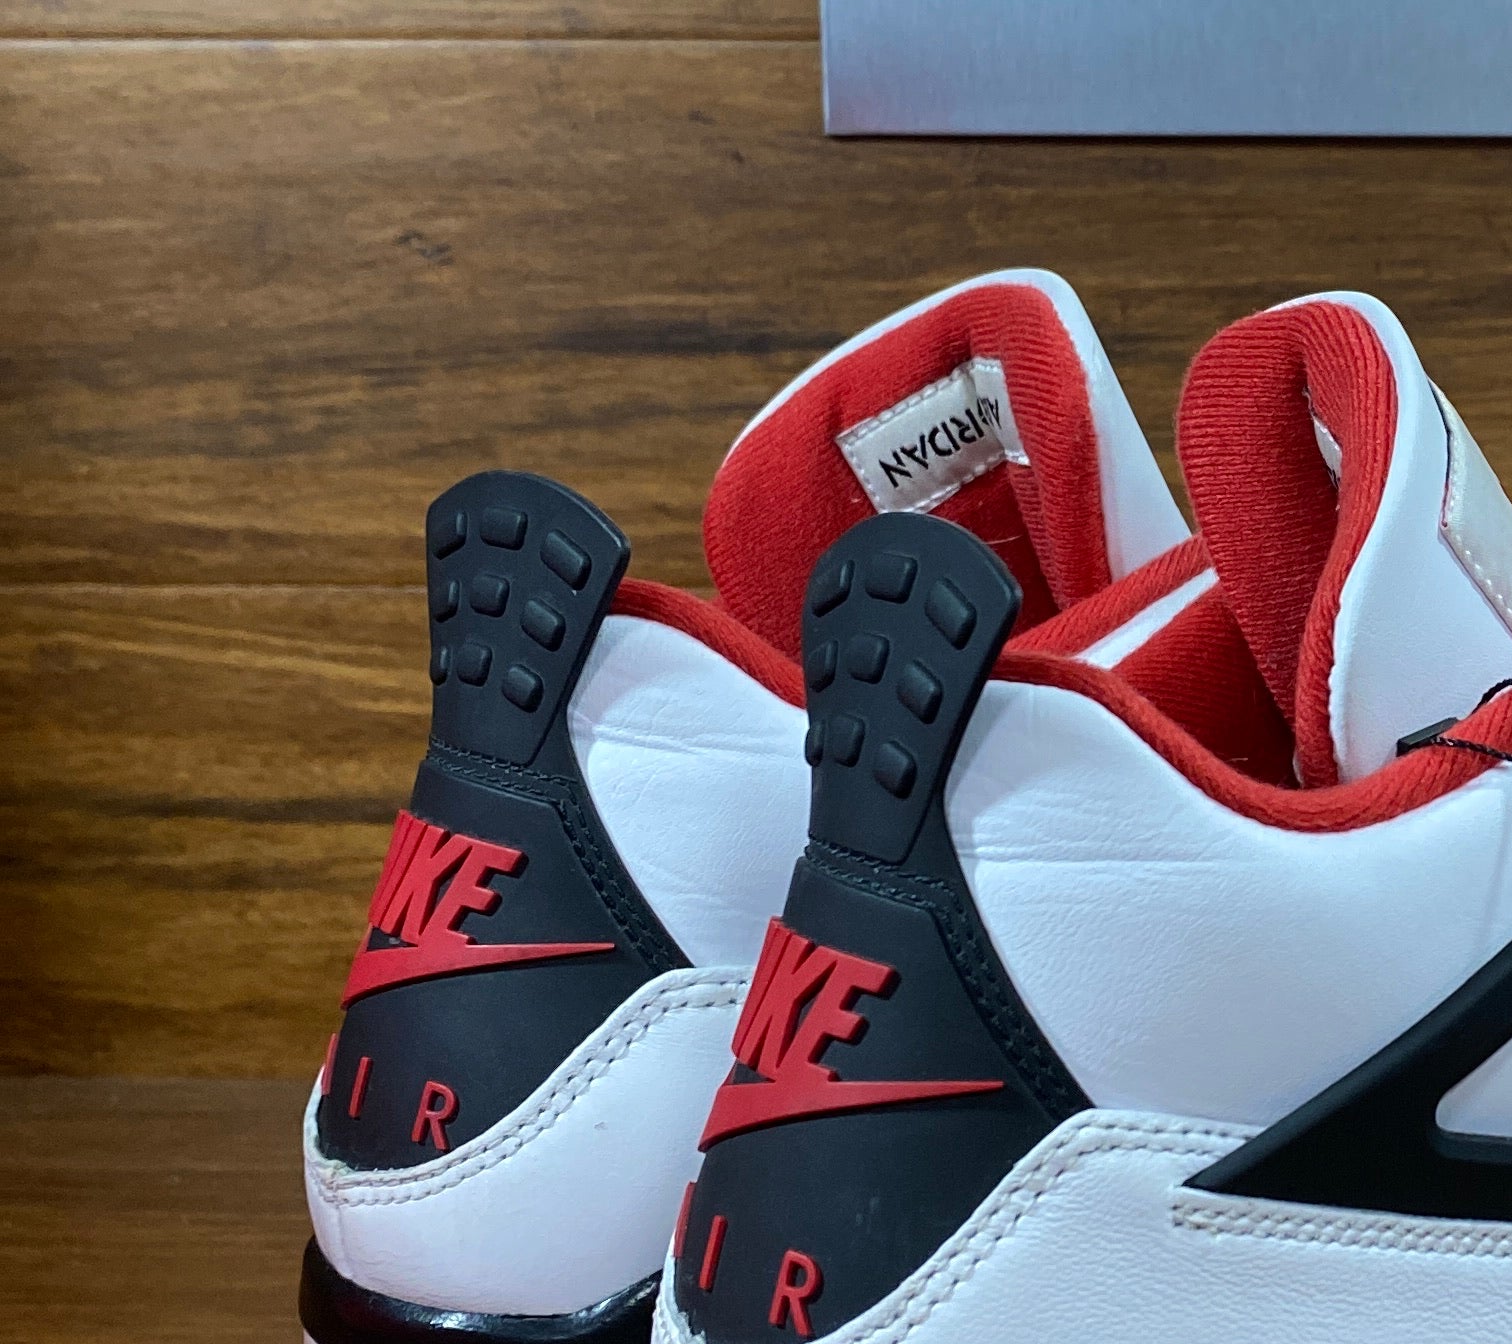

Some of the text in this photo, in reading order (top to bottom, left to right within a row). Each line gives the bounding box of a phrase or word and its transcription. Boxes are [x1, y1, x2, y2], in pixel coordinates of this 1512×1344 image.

[367, 809, 528, 948] IKE
[730, 915, 898, 1086] IKE
[321, 1032, 461, 1153] IR
[673, 1181, 824, 1341] IR
